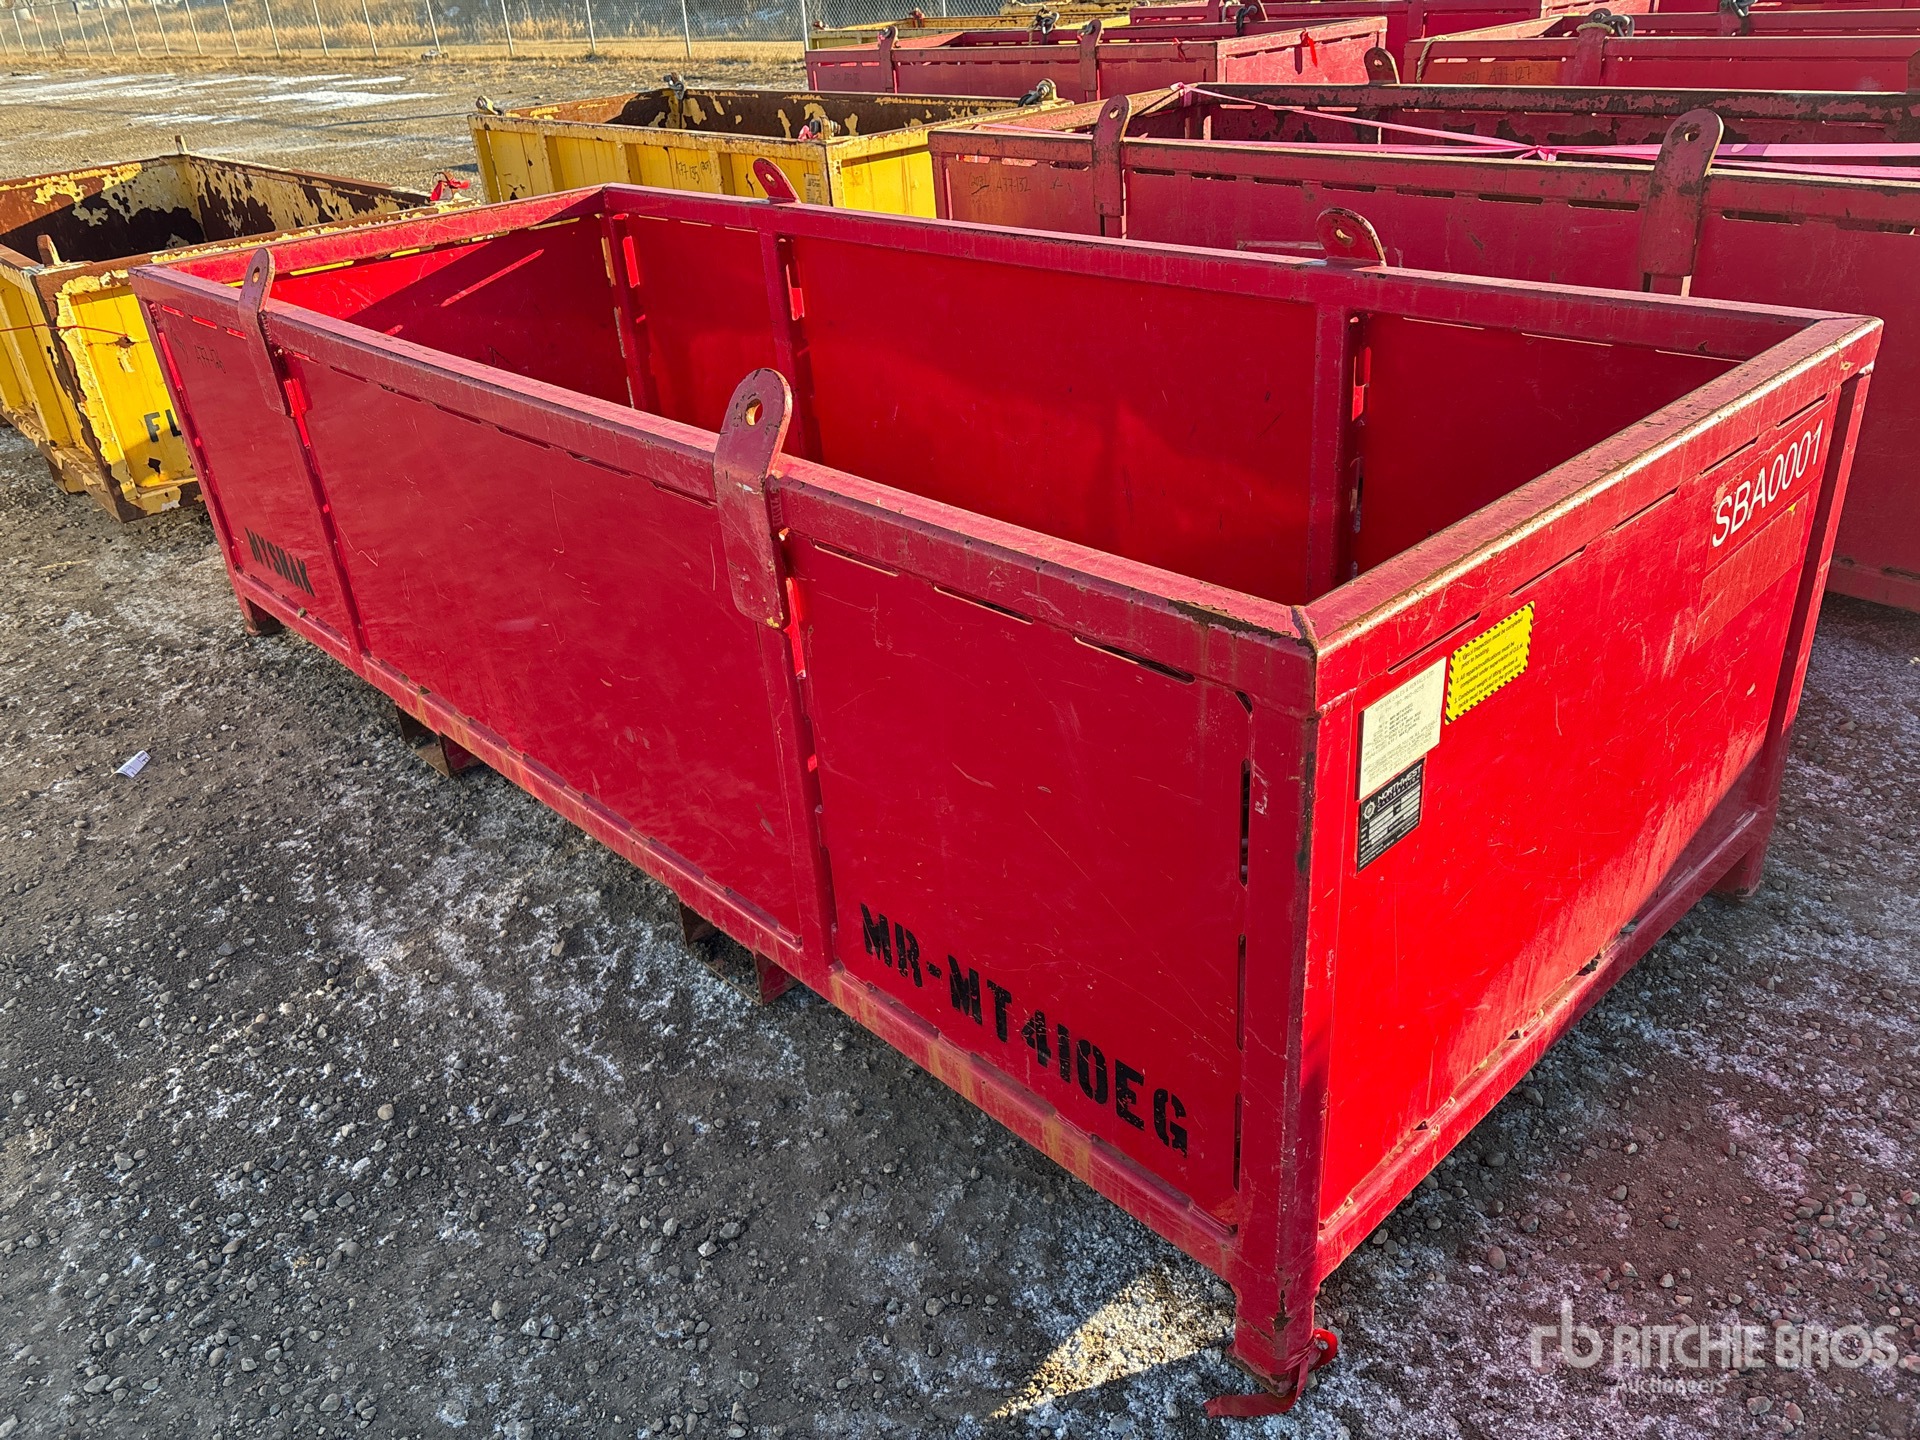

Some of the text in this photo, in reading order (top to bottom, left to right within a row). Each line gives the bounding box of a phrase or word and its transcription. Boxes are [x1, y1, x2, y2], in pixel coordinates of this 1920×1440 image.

[1712, 419, 1824, 547] SBA0001
[1377, 767, 1421, 800] NORTHWEST
[860, 902, 1188, 1159] MR-MT410EG
